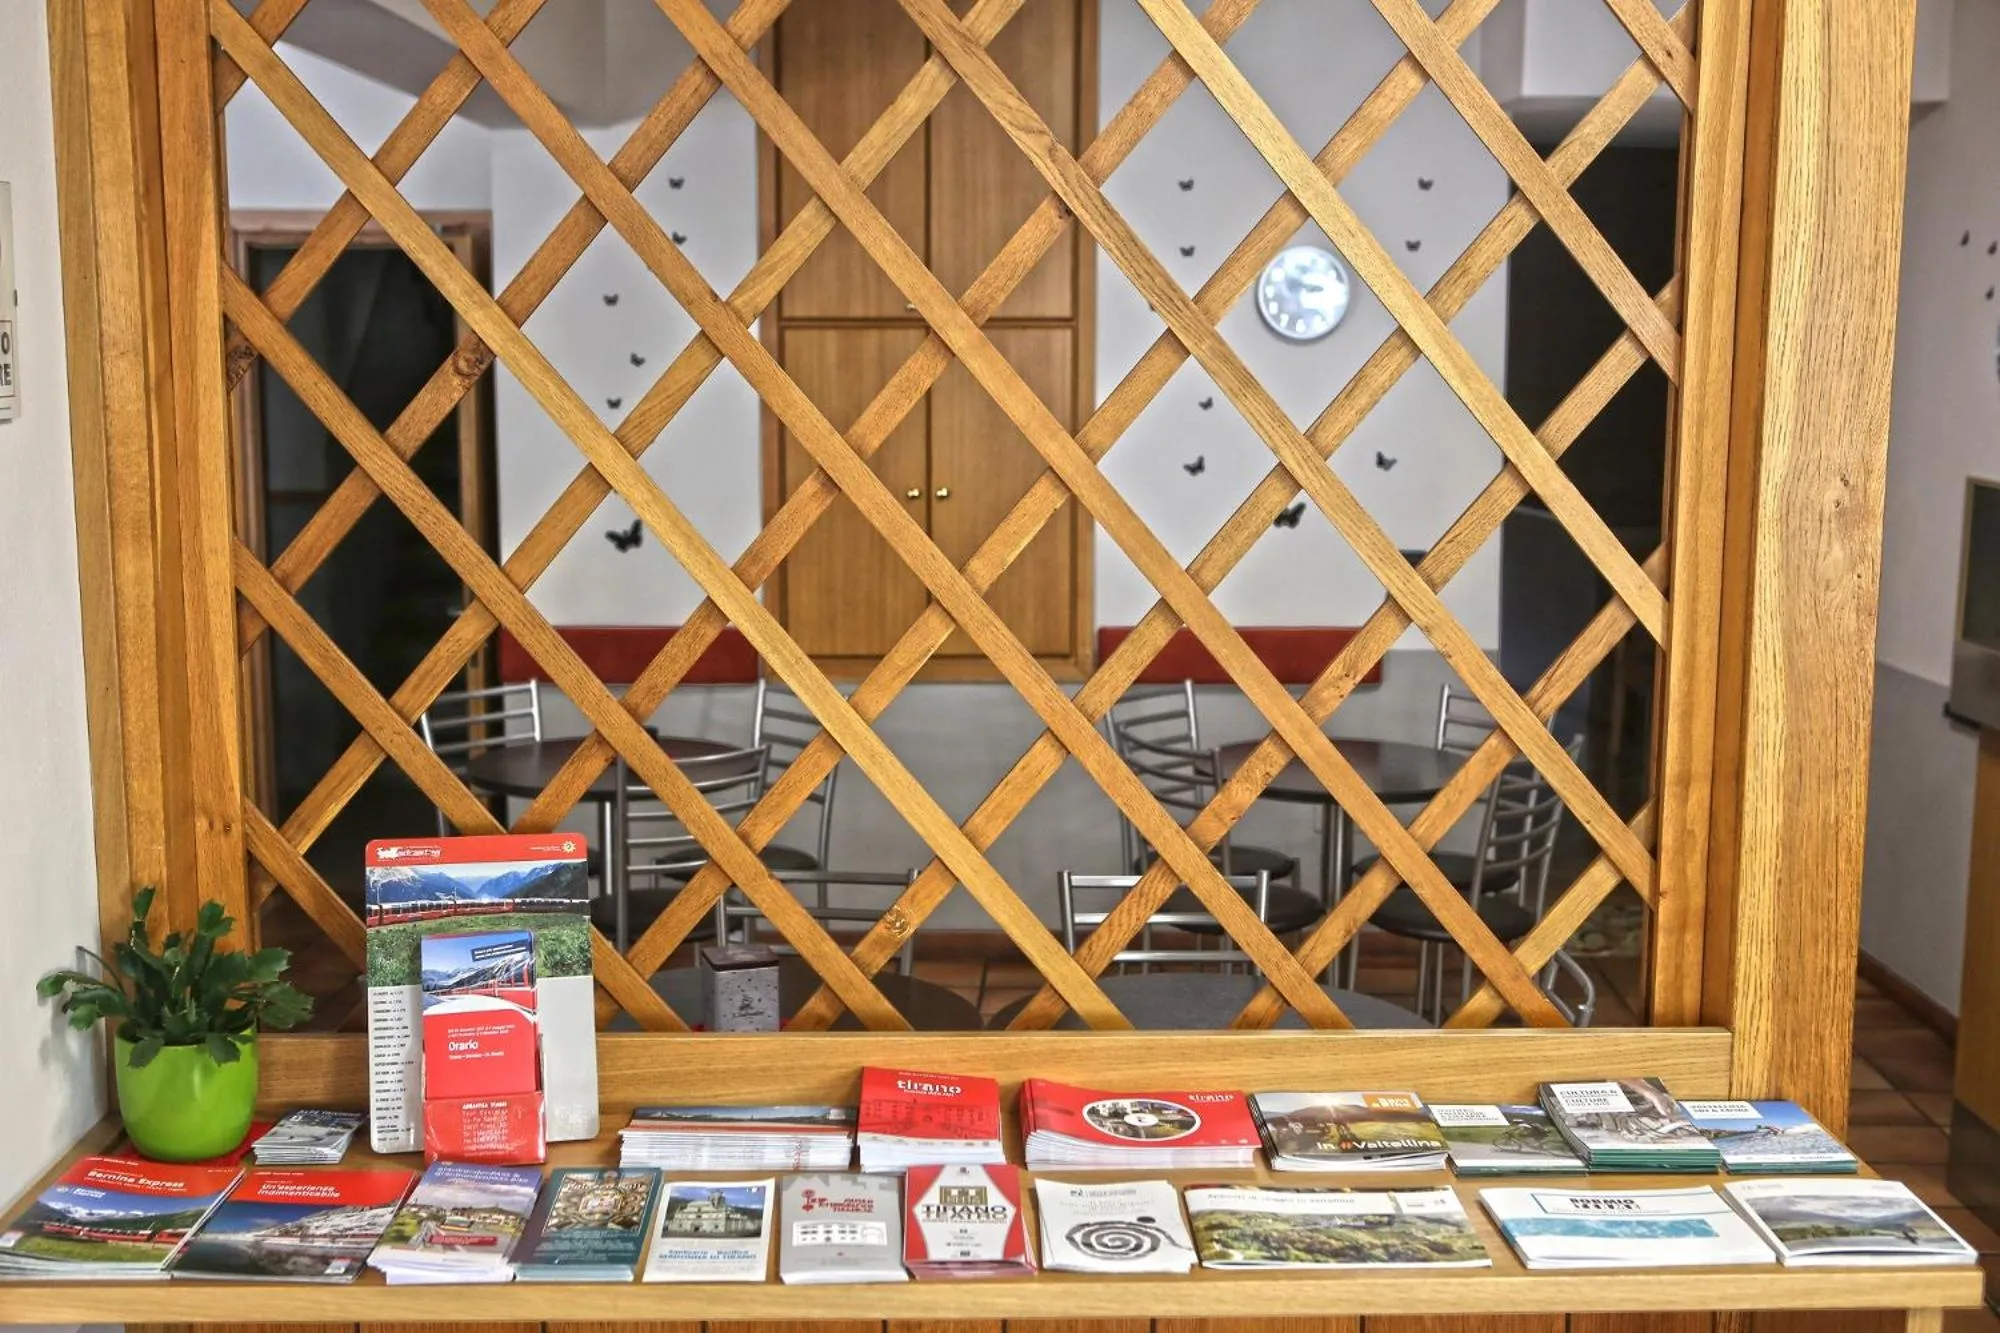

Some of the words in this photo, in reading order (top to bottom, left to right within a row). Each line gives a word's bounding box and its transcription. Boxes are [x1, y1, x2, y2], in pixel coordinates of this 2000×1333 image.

[448, 1039, 479, 1051] Orario
[1352, 1139, 1442, 1150] Valtellina
[87, 1171, 136, 1184] Bernina
[138, 1178, 185, 1189] Express
[921, 1203, 1007, 1213] TIRANO
